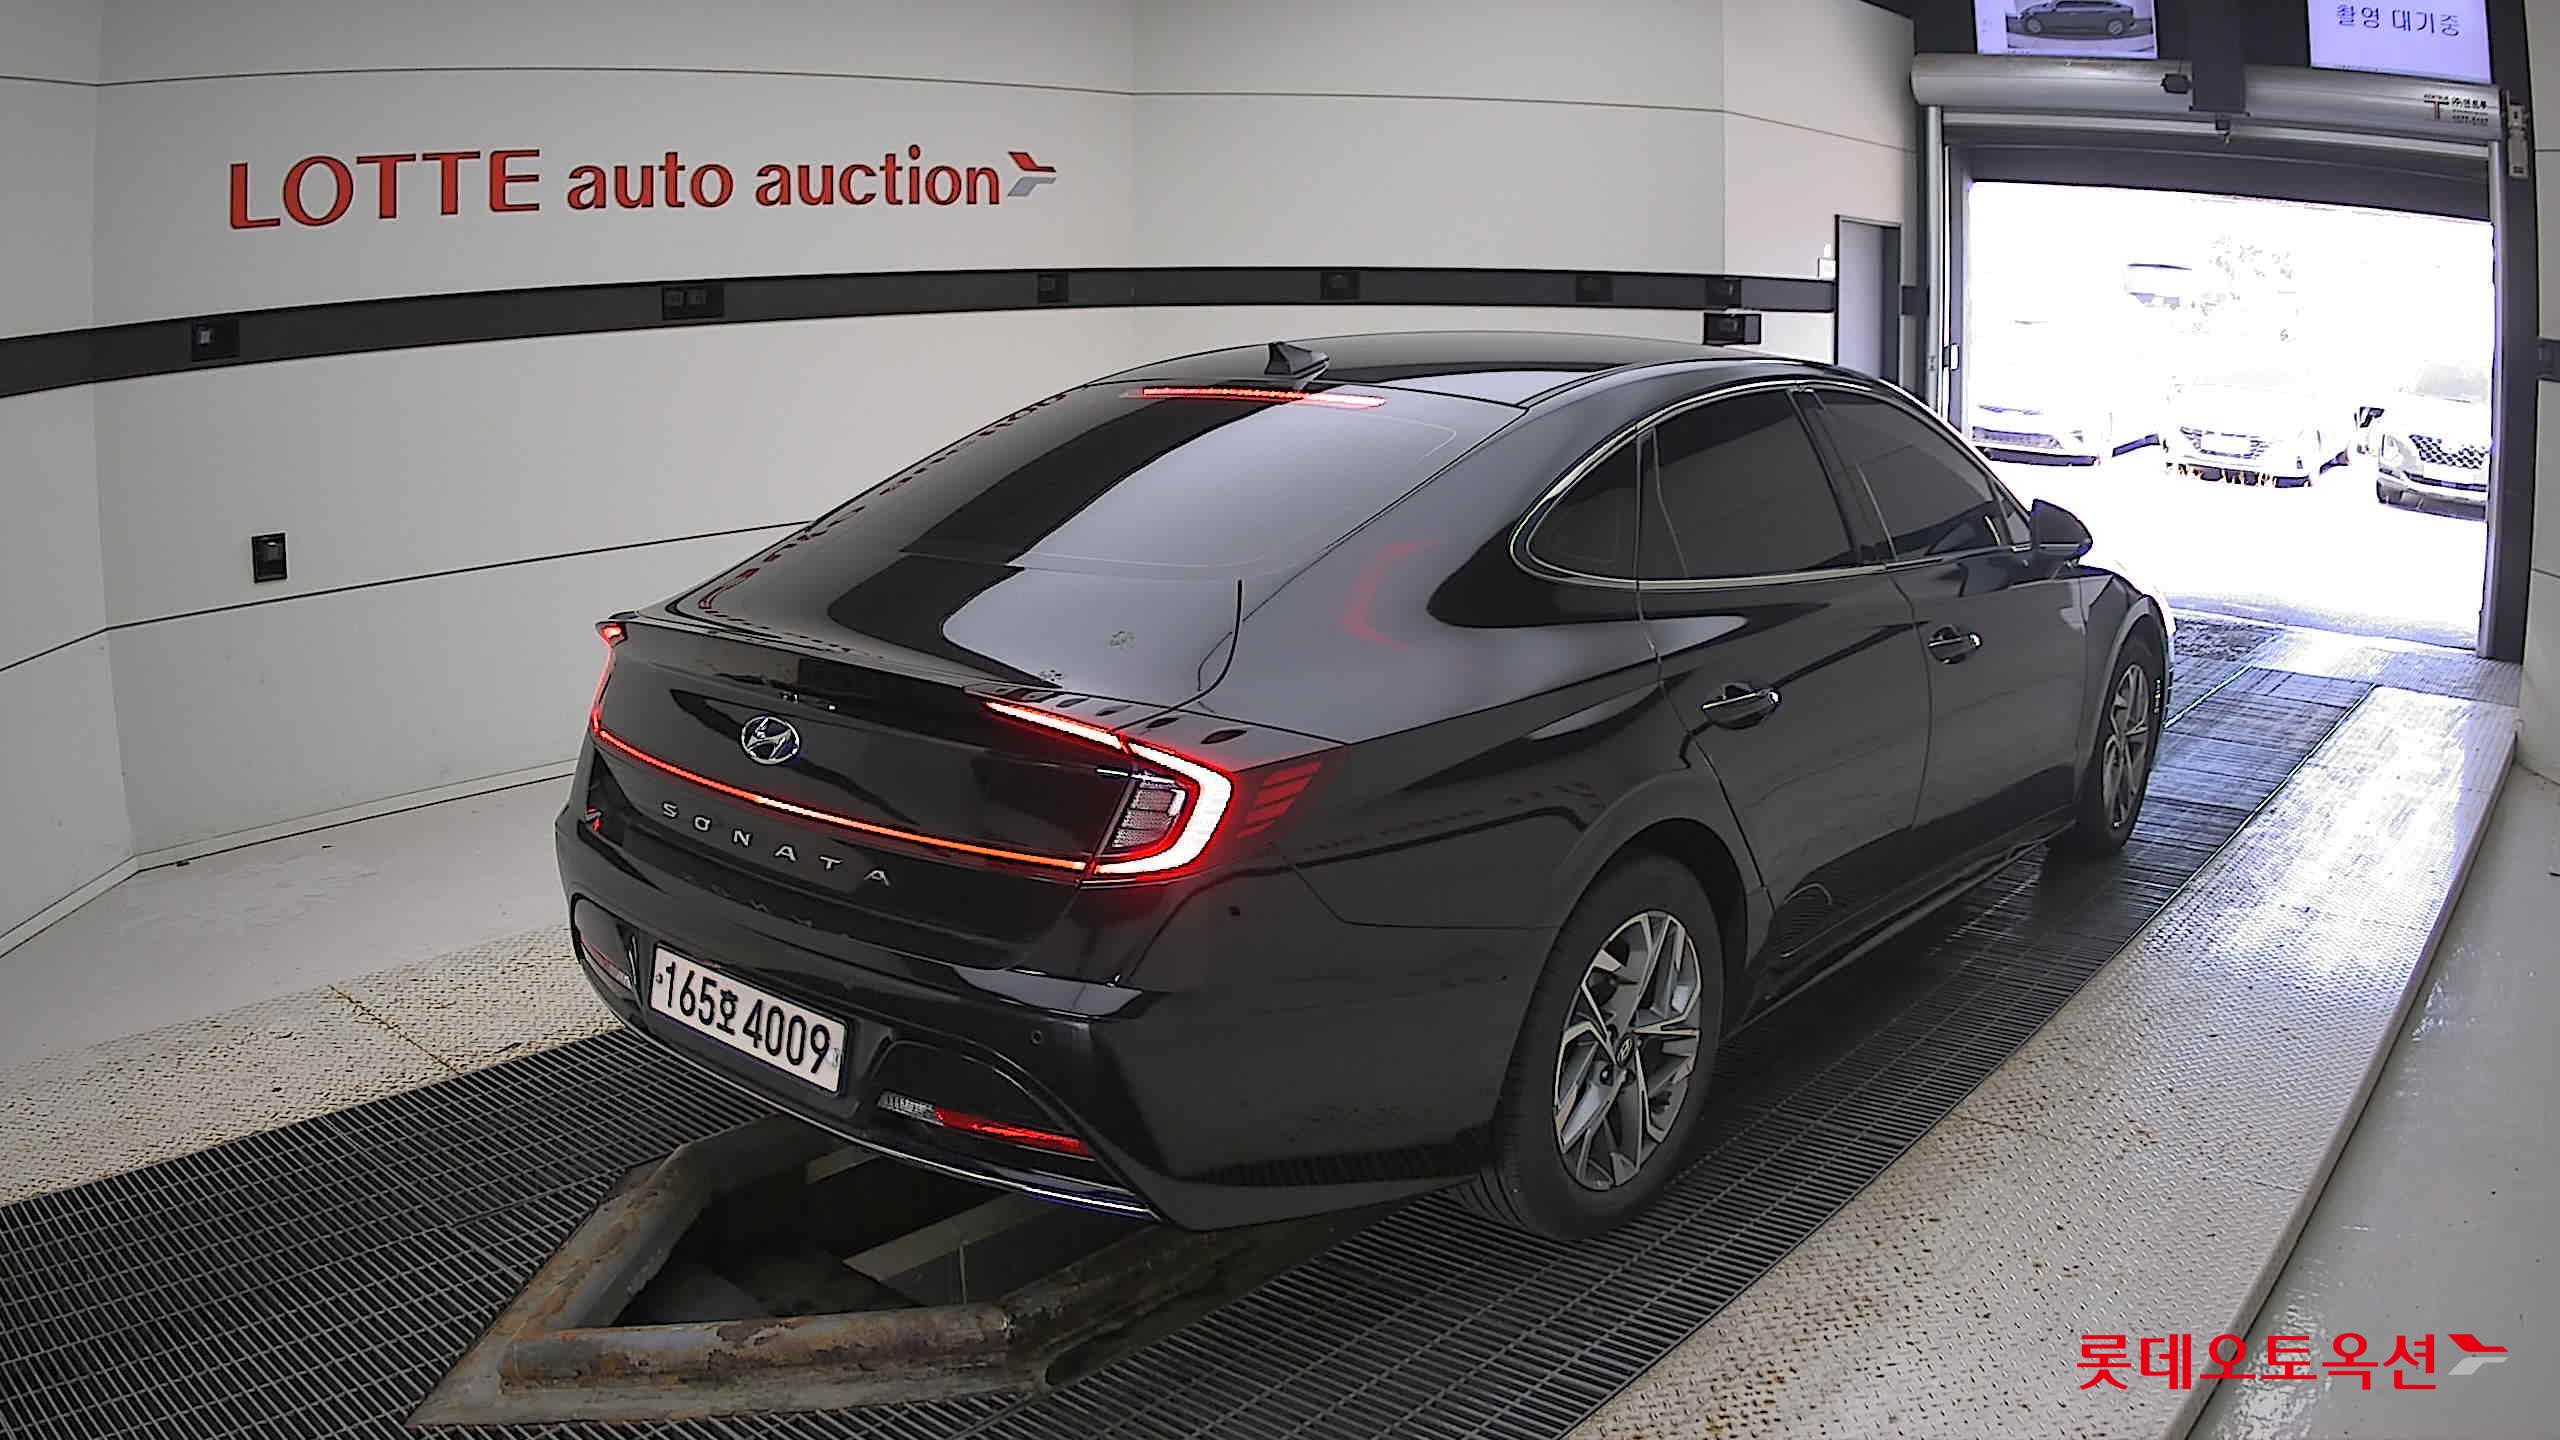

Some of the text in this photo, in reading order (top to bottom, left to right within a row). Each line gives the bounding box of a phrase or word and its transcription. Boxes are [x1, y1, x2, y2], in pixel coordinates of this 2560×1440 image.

[229, 144, 1001, 230] LOTTE auto auction
[662, 802, 891, 886] SONATA
[742, 999, 831, 1074] 4009
